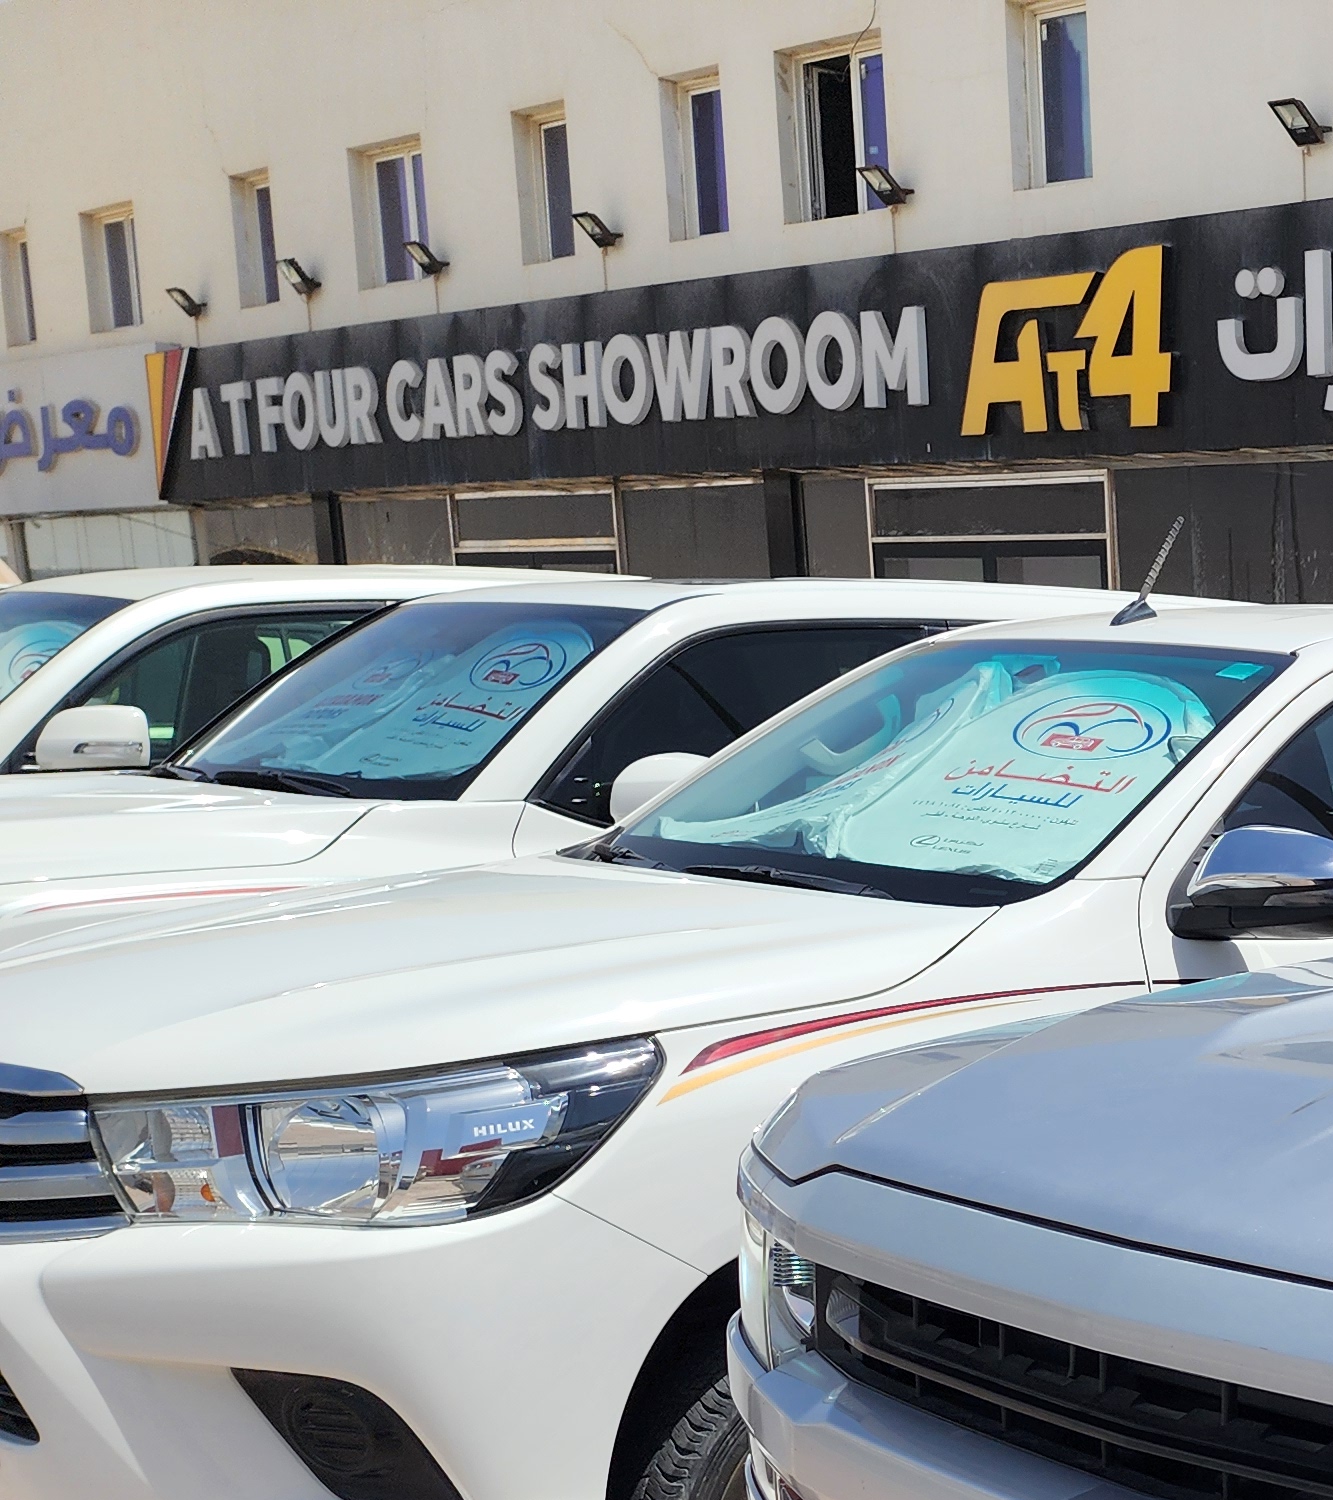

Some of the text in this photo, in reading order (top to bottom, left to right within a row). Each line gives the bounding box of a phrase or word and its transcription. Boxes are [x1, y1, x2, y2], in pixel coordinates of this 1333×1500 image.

[191, 305, 930, 460] A T FOUR CARS SHOWROOM
[943, 758, 1138, 795] التضامن
[951, 781, 1084, 809] للسيارات
[473, 1118, 535, 1138] HILUX
